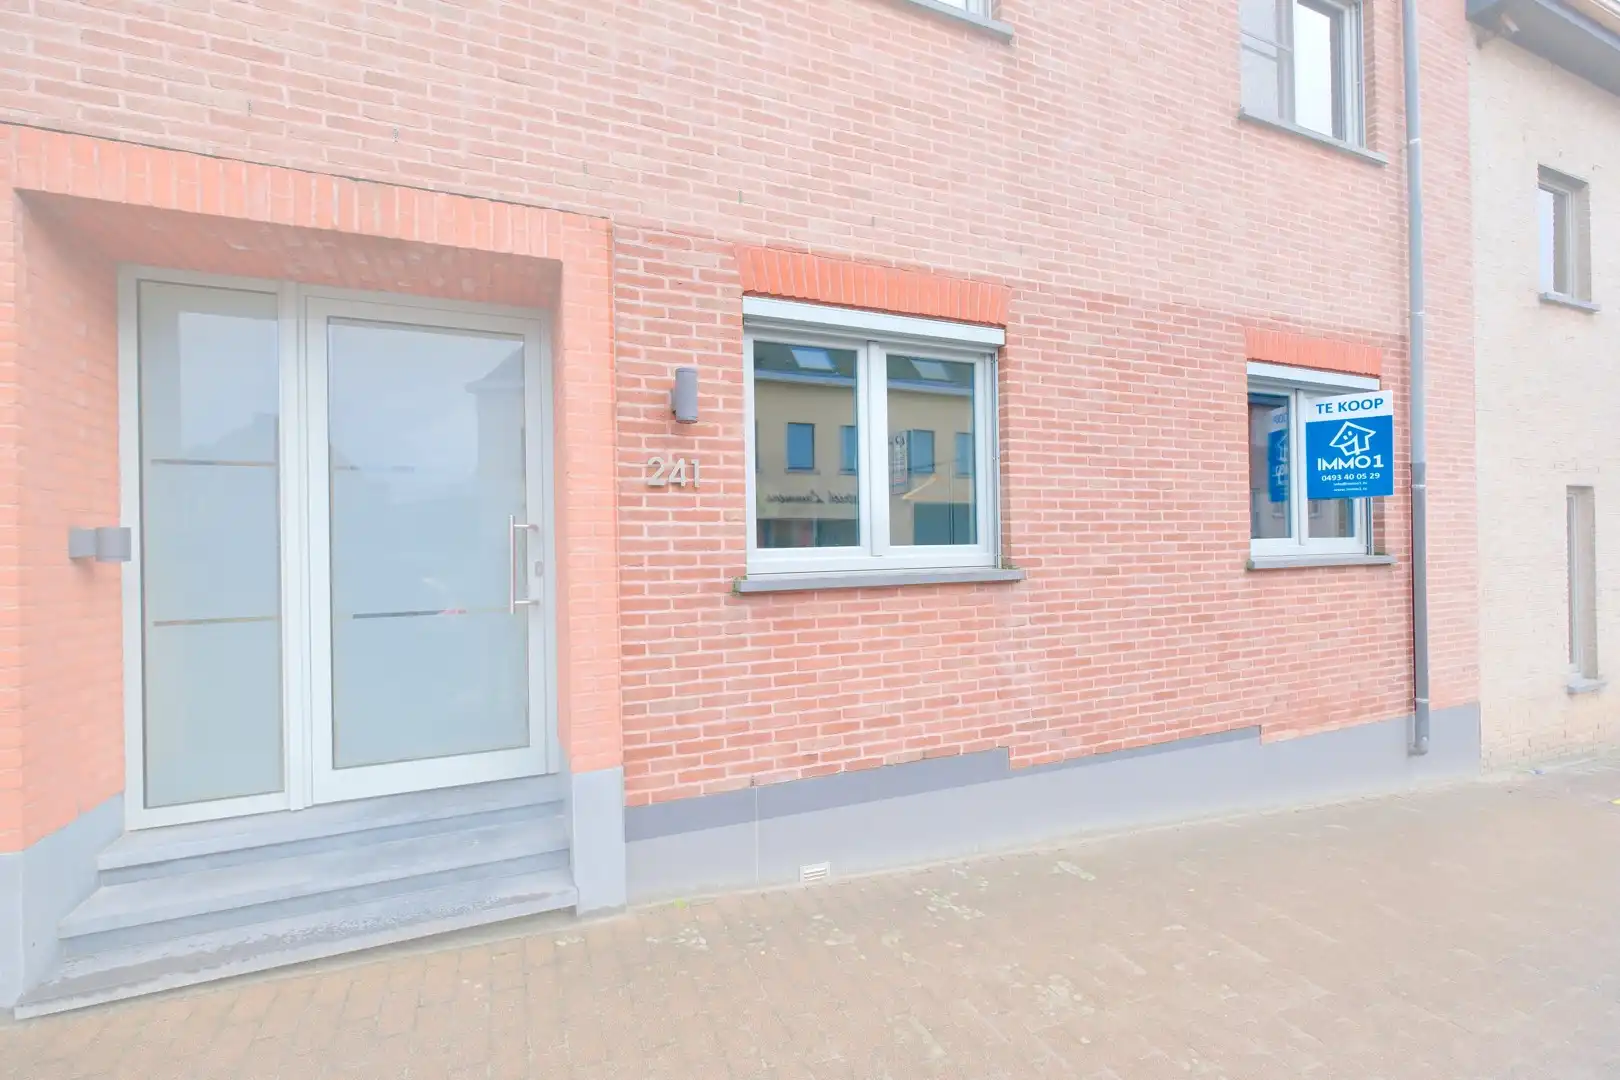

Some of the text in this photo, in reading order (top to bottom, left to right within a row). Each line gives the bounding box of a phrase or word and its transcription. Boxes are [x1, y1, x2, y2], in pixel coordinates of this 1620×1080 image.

[1316, 398, 1384, 414] TE KOOP
[647, 456, 700, 488] 241
[1321, 474, 1342, 482] 0493
[1356, 472, 1367, 480] 05
[1369, 472, 1380, 480] 29
